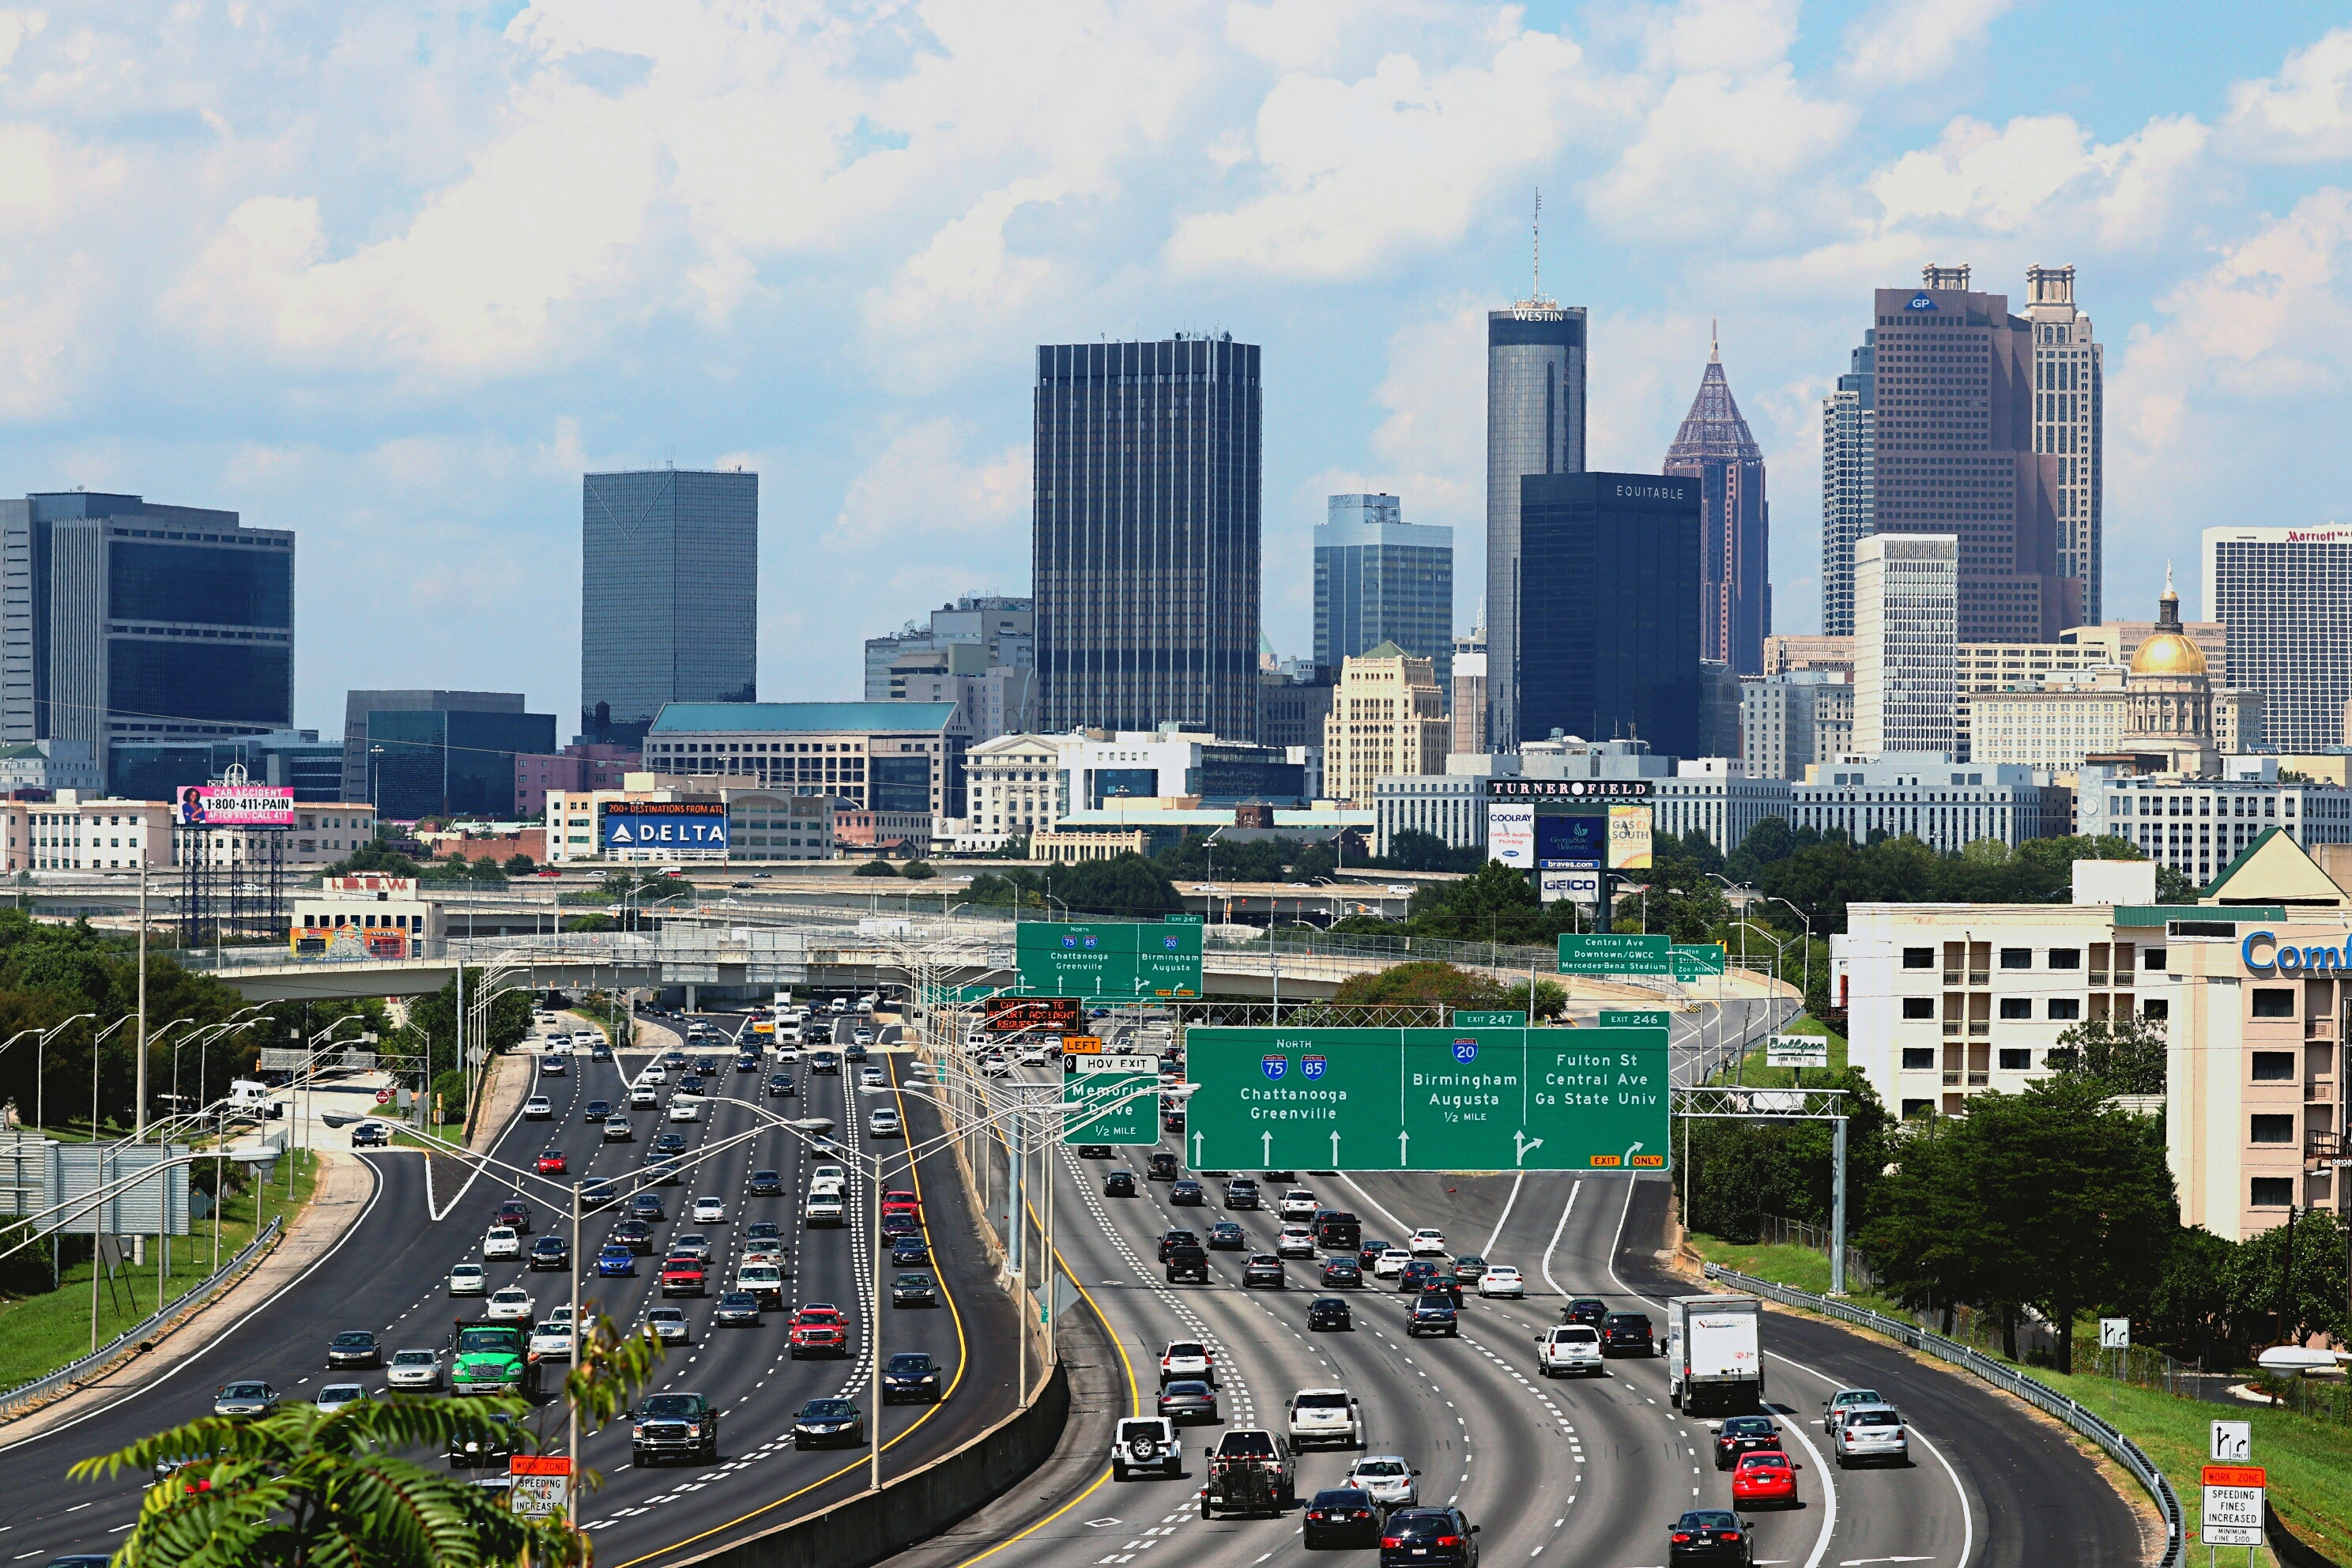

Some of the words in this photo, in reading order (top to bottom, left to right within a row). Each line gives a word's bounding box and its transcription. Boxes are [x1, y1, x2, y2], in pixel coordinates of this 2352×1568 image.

[1913, 300, 1930, 308] GP
[1512, 307, 1563, 322] WESTIN
[1616, 485, 1683, 499] EQUITABLE
[2286, 530, 2335, 542] Marriott
[1493, 782, 1570, 794] TURNER
[1587, 783, 1646, 794] FIELD
[630, 805, 685, 813] DESTINATIONS
[686, 805, 708, 813] FROM
[709, 805, 724, 814] ATL
[639, 824, 725, 842] DELTA
[1612, 831, 1649, 839] SOUTH
[1544, 880, 1596, 890] GEICO
[1050, 952, 1109, 962] Chattanooga
[1141, 953, 1199, 963] Birmingham
[1152, 963, 1190, 972] Augusta
[1052, 1001, 1065, 1009] TO
[1029, 1011, 1076, 1020] ACCIDENT
[1488, 1015, 1513, 1024] 247
[1633, 1015, 1658, 1024] 246
[1067, 1041, 1097, 1050] LEFT
[1457, 1046, 1475, 1058] 20
[1087, 1059, 1113, 1068] HOV
[1120, 1059, 1147, 1068] EXIT
[1557, 1054, 1611, 1066] Fulton
[1620, 1054, 1638, 1066] St
[1266, 1062, 1283, 1075] 75
[1305, 1062, 1323, 1075] 85
[1413, 1073, 1517, 1089] Birmingham
[1546, 1073, 1608, 1085] Central
[1618, 1073, 1648, 1085] Ave
[1240, 1087, 1348, 1104] Chattanooga
[1535, 1093, 1555, 1105] Ga
[1564, 1093, 1609, 1105] State
[1619, 1093, 1657, 1105] Univ
[1429, 1093, 1499, 1109] Augusta
[1250, 1107, 1336, 1119] Greenville
[1634, 1156, 1661, 1165] ONLY
[545, 1462, 565, 1472] ZONE
[2208, 1472, 2231, 1482] WORK
[2237, 1473, 2260, 1483] ZONE
[519, 1479, 561, 1488] SPEEDING
[2212, 1490, 2255, 1499] SPEEDING
[2220, 1502, 2245, 1511] FINES
[2209, 1513, 2256, 1523] INCREASED
[2234, 1534, 2250, 1543] $100
